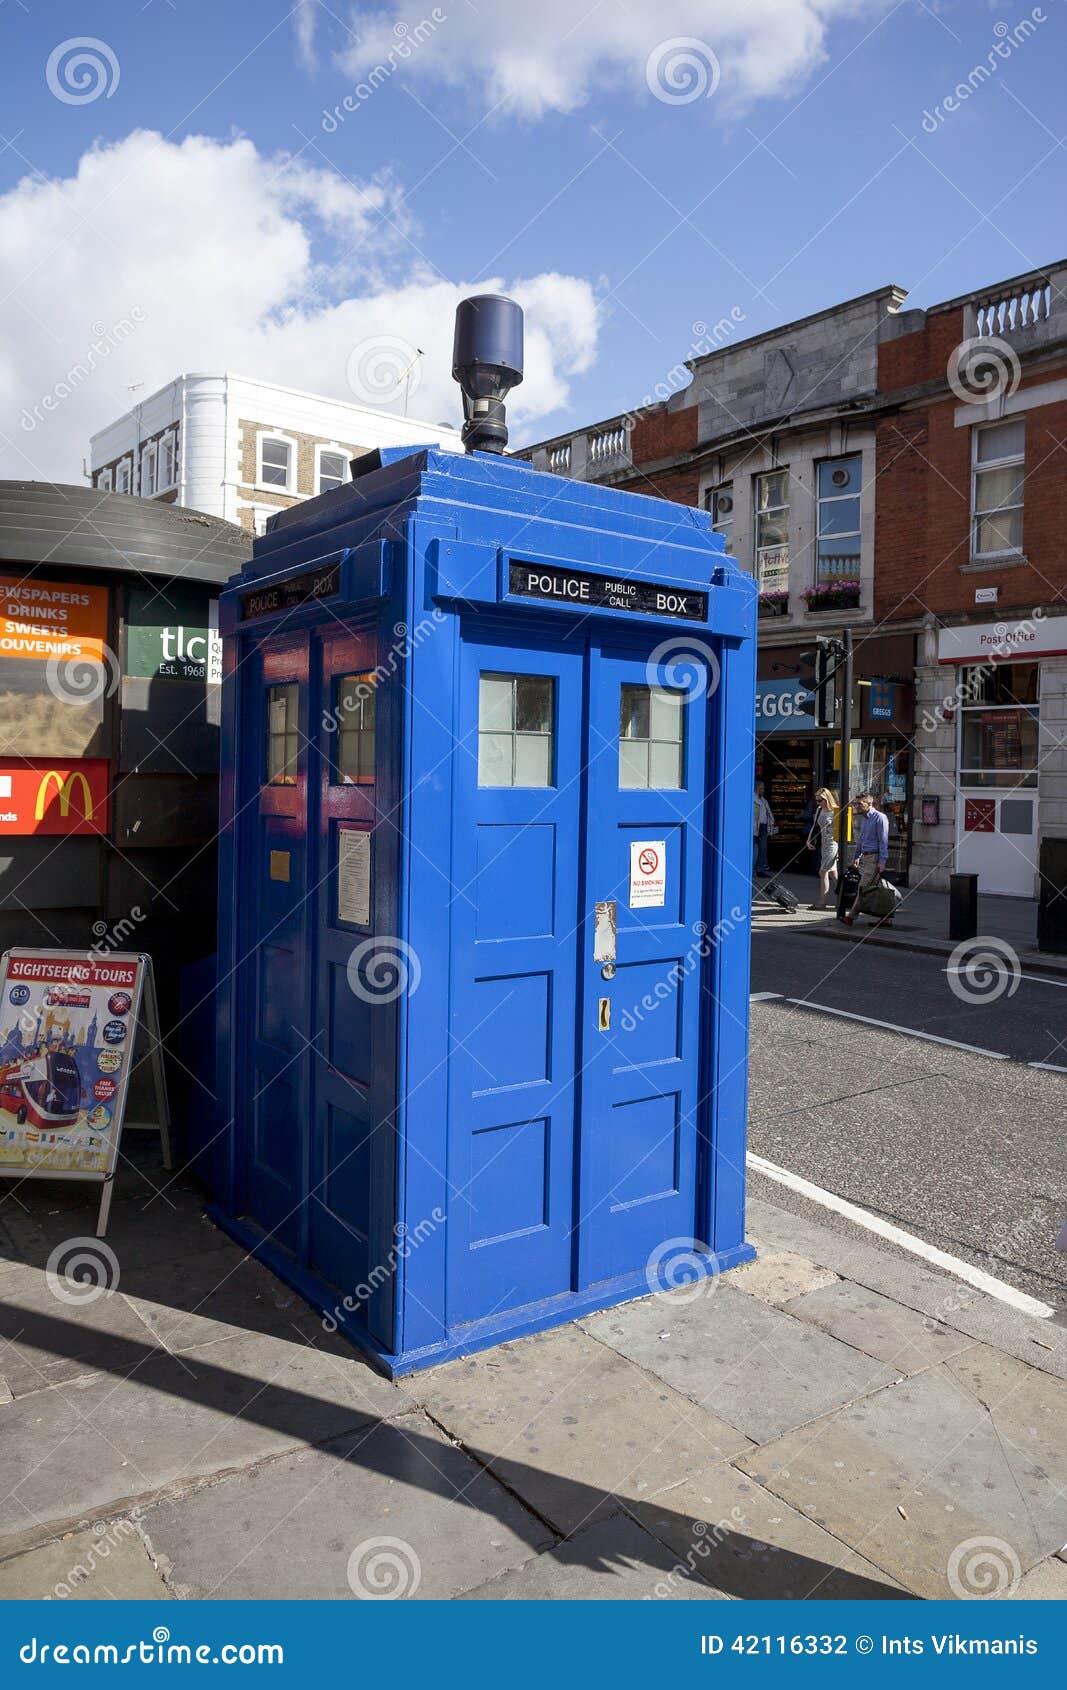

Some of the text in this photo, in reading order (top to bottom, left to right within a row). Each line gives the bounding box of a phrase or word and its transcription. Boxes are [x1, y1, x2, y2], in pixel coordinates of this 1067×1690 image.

[249, 591, 278, 613] POLICE
[313, 575, 334, 596] BOX
[528, 573, 688, 613] POLICE PUBLIC CALL BOX
[8, 603, 68, 621] DRINKS
[5, 621, 68, 638] SWEETS
[980, 631, 1035, 645] Post Office
[160, 626, 206, 663] tlc
[159, 663, 205, 677] Est. 1968
[12, 962, 134, 983] SIGHTSEEING TOURS
